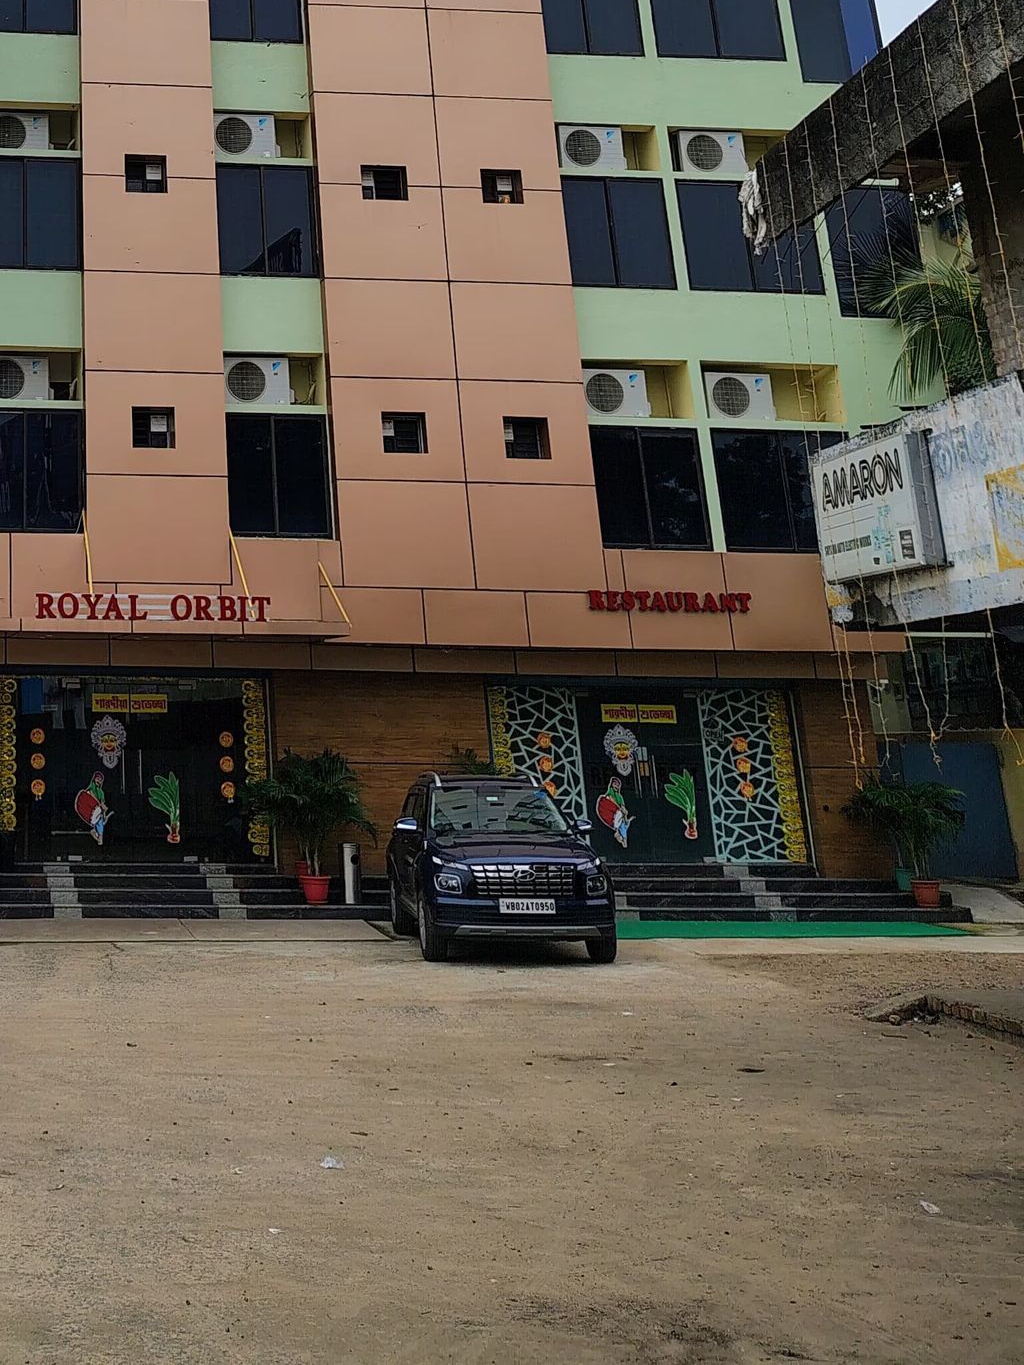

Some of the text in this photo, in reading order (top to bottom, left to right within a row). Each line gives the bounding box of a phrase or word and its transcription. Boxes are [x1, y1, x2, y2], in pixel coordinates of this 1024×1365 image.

[822, 448, 904, 512] AMARON
[35, 592, 271, 622] ROYAL ORBIT
[588, 590, 752, 613] RESTAURANT
[505, 901, 555, 911] WB02AT0950
